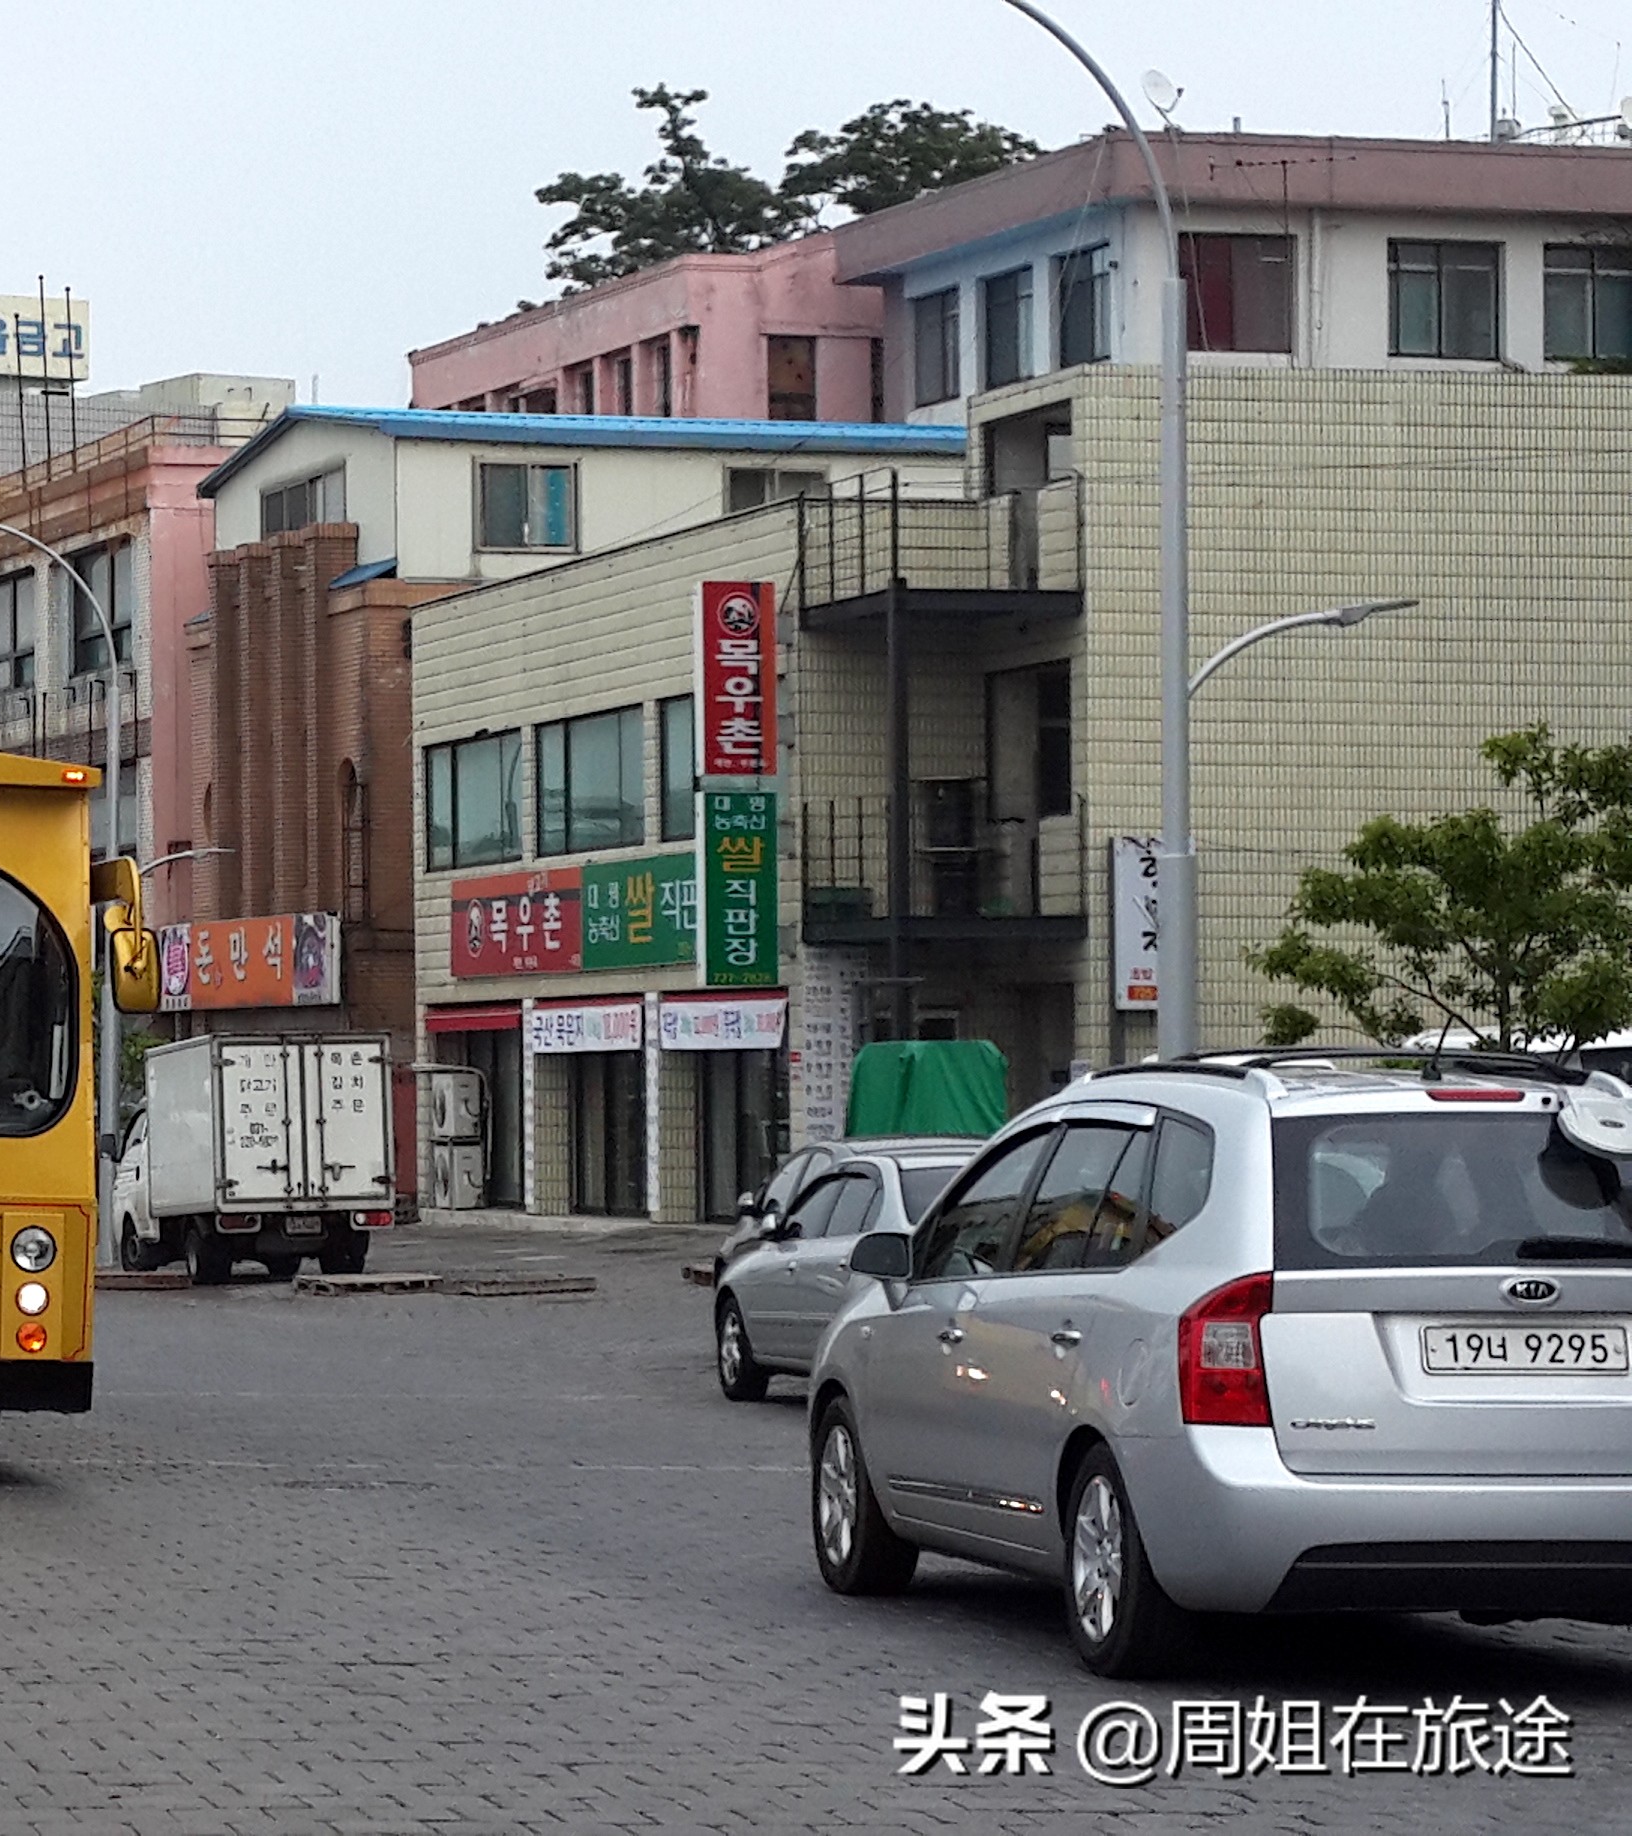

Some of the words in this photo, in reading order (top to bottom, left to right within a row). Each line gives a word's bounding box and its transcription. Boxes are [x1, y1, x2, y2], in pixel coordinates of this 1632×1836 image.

[714, 639, 764, 756] 목우촌
[716, 836, 766, 873] 쌀
[489, 892, 562, 953] 목우촌
[625, 871, 655, 944] 쌀
[723, 879, 759, 967] 직판장
[1515, 1282, 1549, 1298] KIA
[1445, 1333, 1507, 1363] 19너
[1524, 1333, 1609, 1364] 9295
